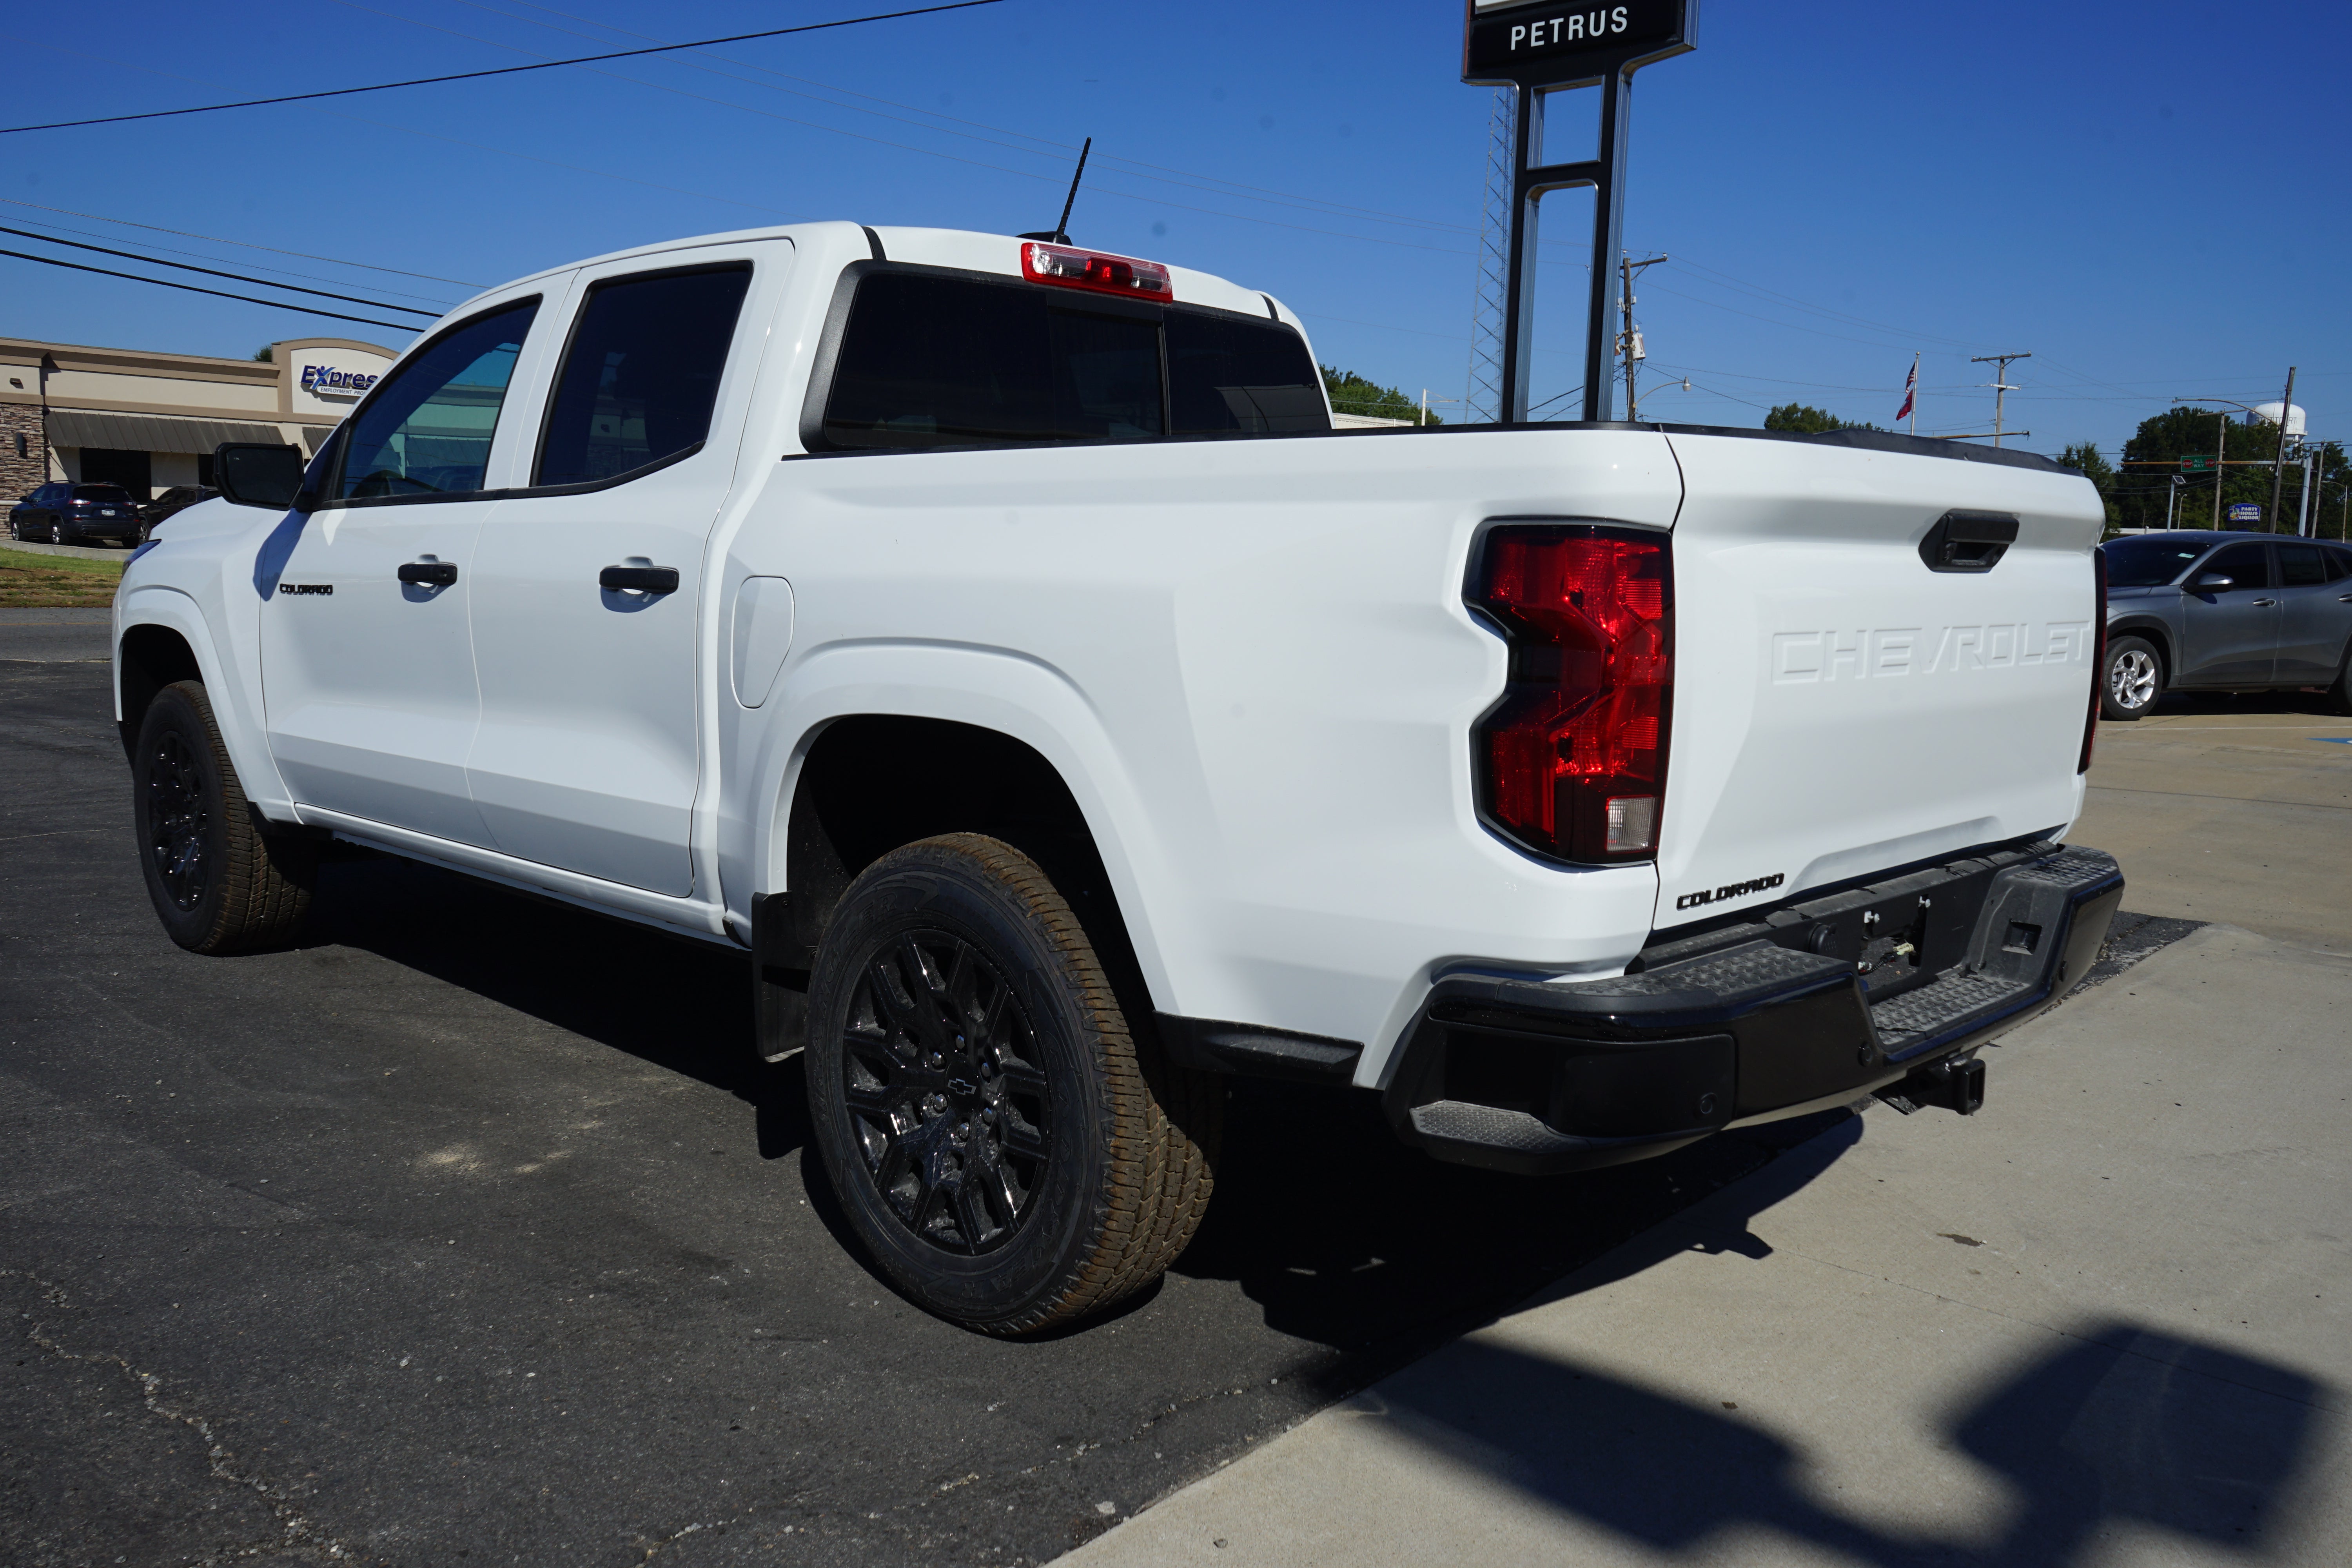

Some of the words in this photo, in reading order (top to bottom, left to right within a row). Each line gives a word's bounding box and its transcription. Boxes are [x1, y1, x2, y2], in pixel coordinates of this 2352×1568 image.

[1510, 6, 1628, 51] PETRUS
[279, 583, 333, 593] COLORADO
[1772, 621, 2091, 685] CHEVROLET
[1676, 873, 1784, 910] COLORADO
